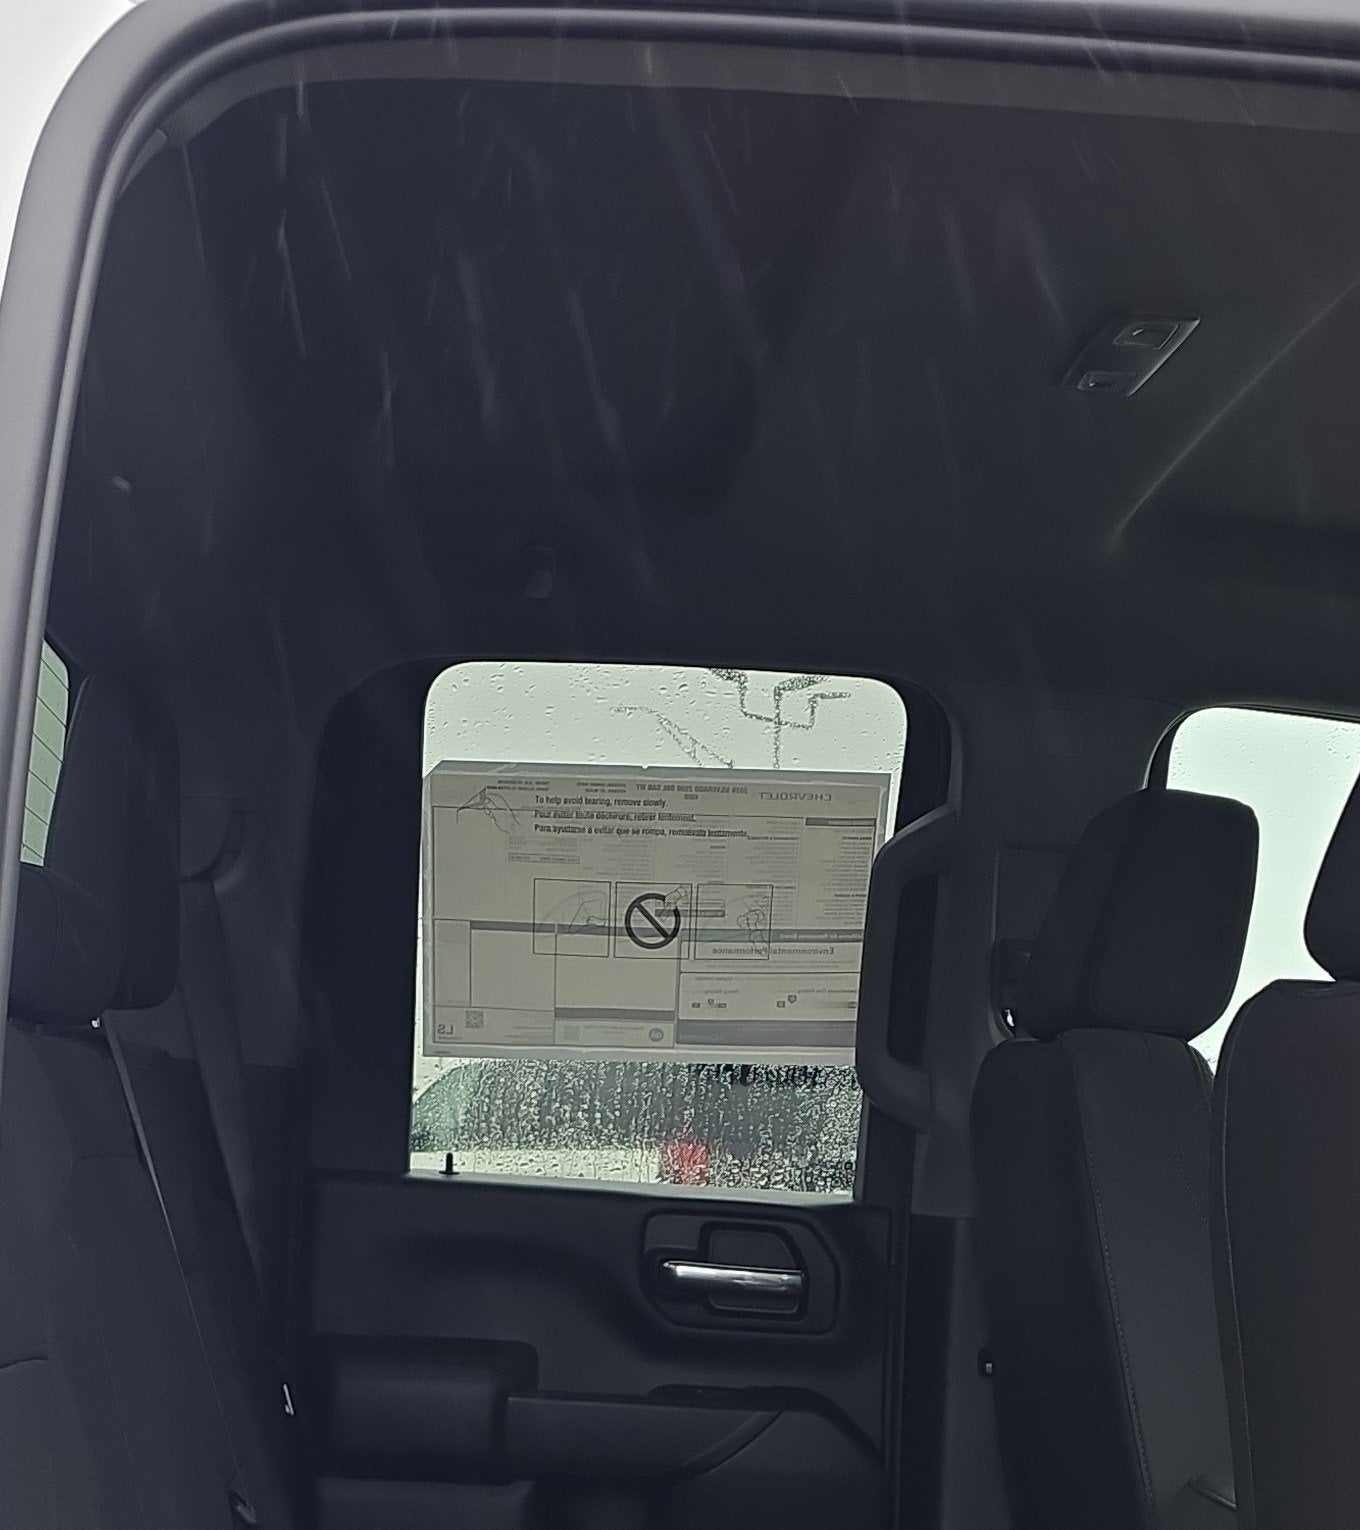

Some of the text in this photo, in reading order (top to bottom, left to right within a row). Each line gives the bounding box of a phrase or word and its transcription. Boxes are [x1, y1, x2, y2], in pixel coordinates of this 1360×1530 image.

[535, 795, 544, 804] To
[546, 796, 562, 806] help
[563, 796, 583, 805] avoid
[614, 798, 641, 807] remove
[535, 824, 551, 832] Para
[594, 826, 614, 835] evitar
